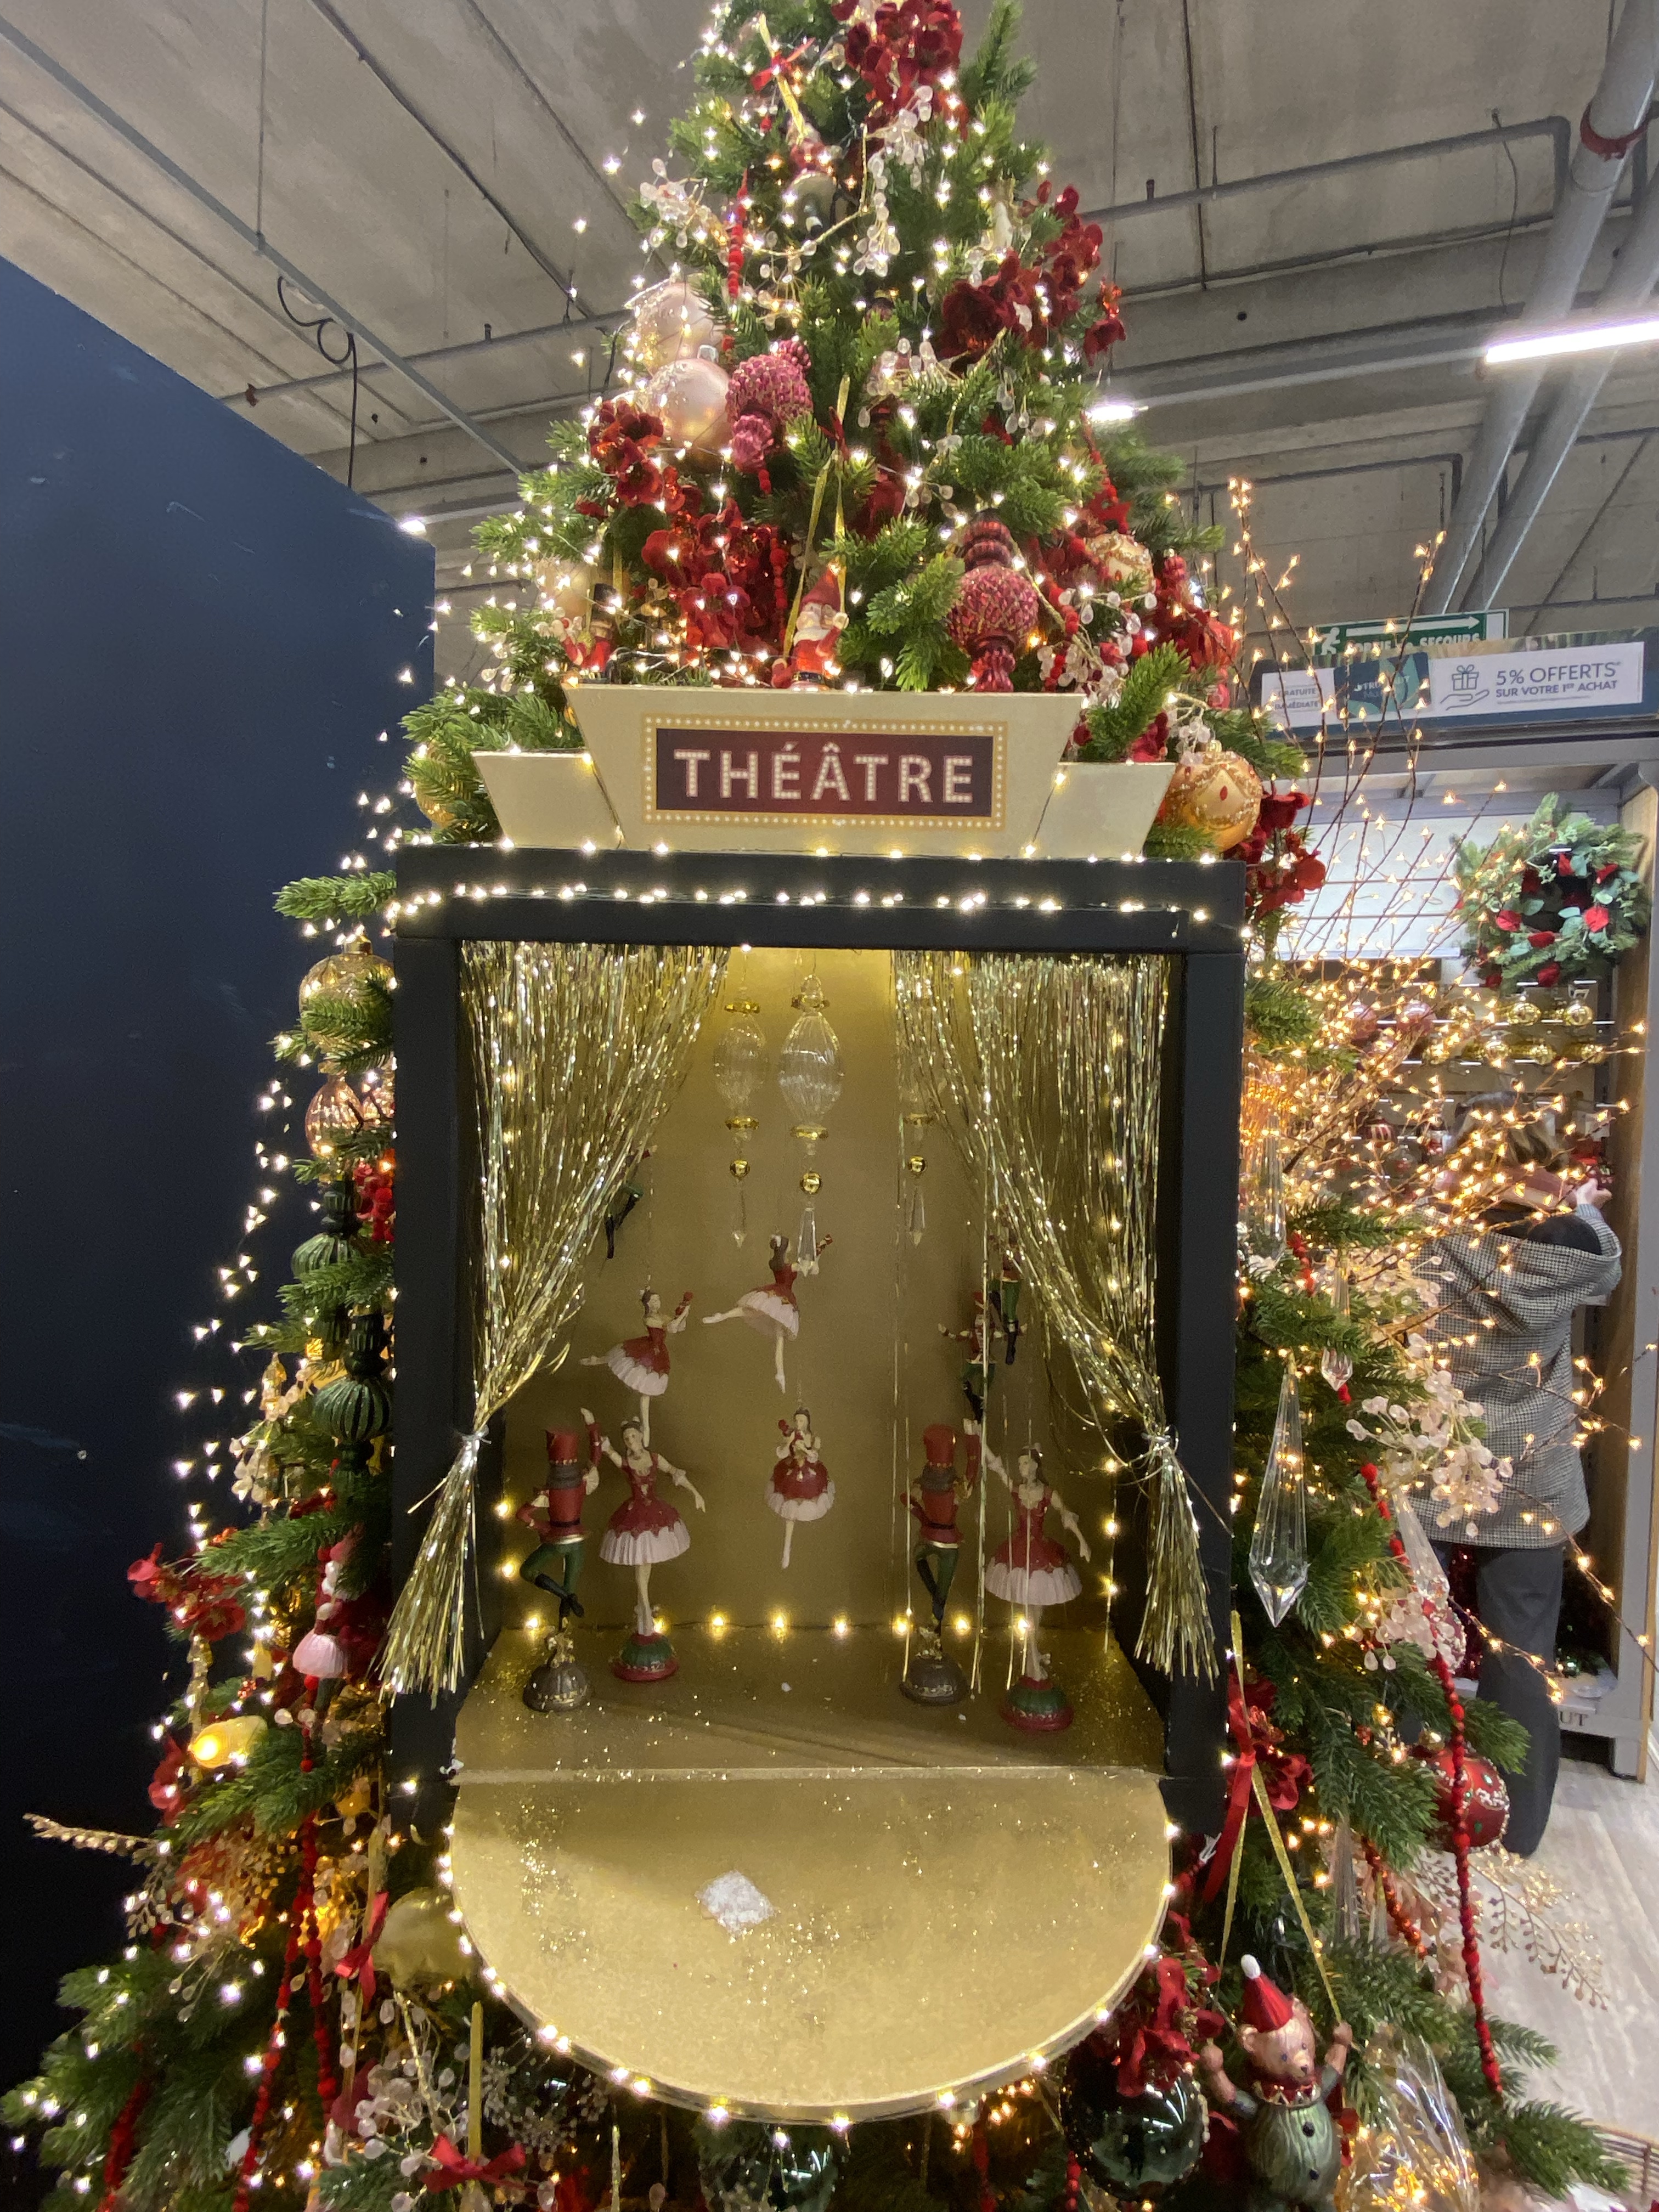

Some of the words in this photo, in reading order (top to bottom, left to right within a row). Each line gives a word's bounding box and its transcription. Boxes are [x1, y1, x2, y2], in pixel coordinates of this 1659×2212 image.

[1496, 669, 1525, 686] 5%
[1496, 687, 1519, 697] SUR
[1521, 684, 1560, 696] VOTRE
[1577, 680, 1618, 691] ACHAT
[673, 742, 974, 803] THÉÂTRE
